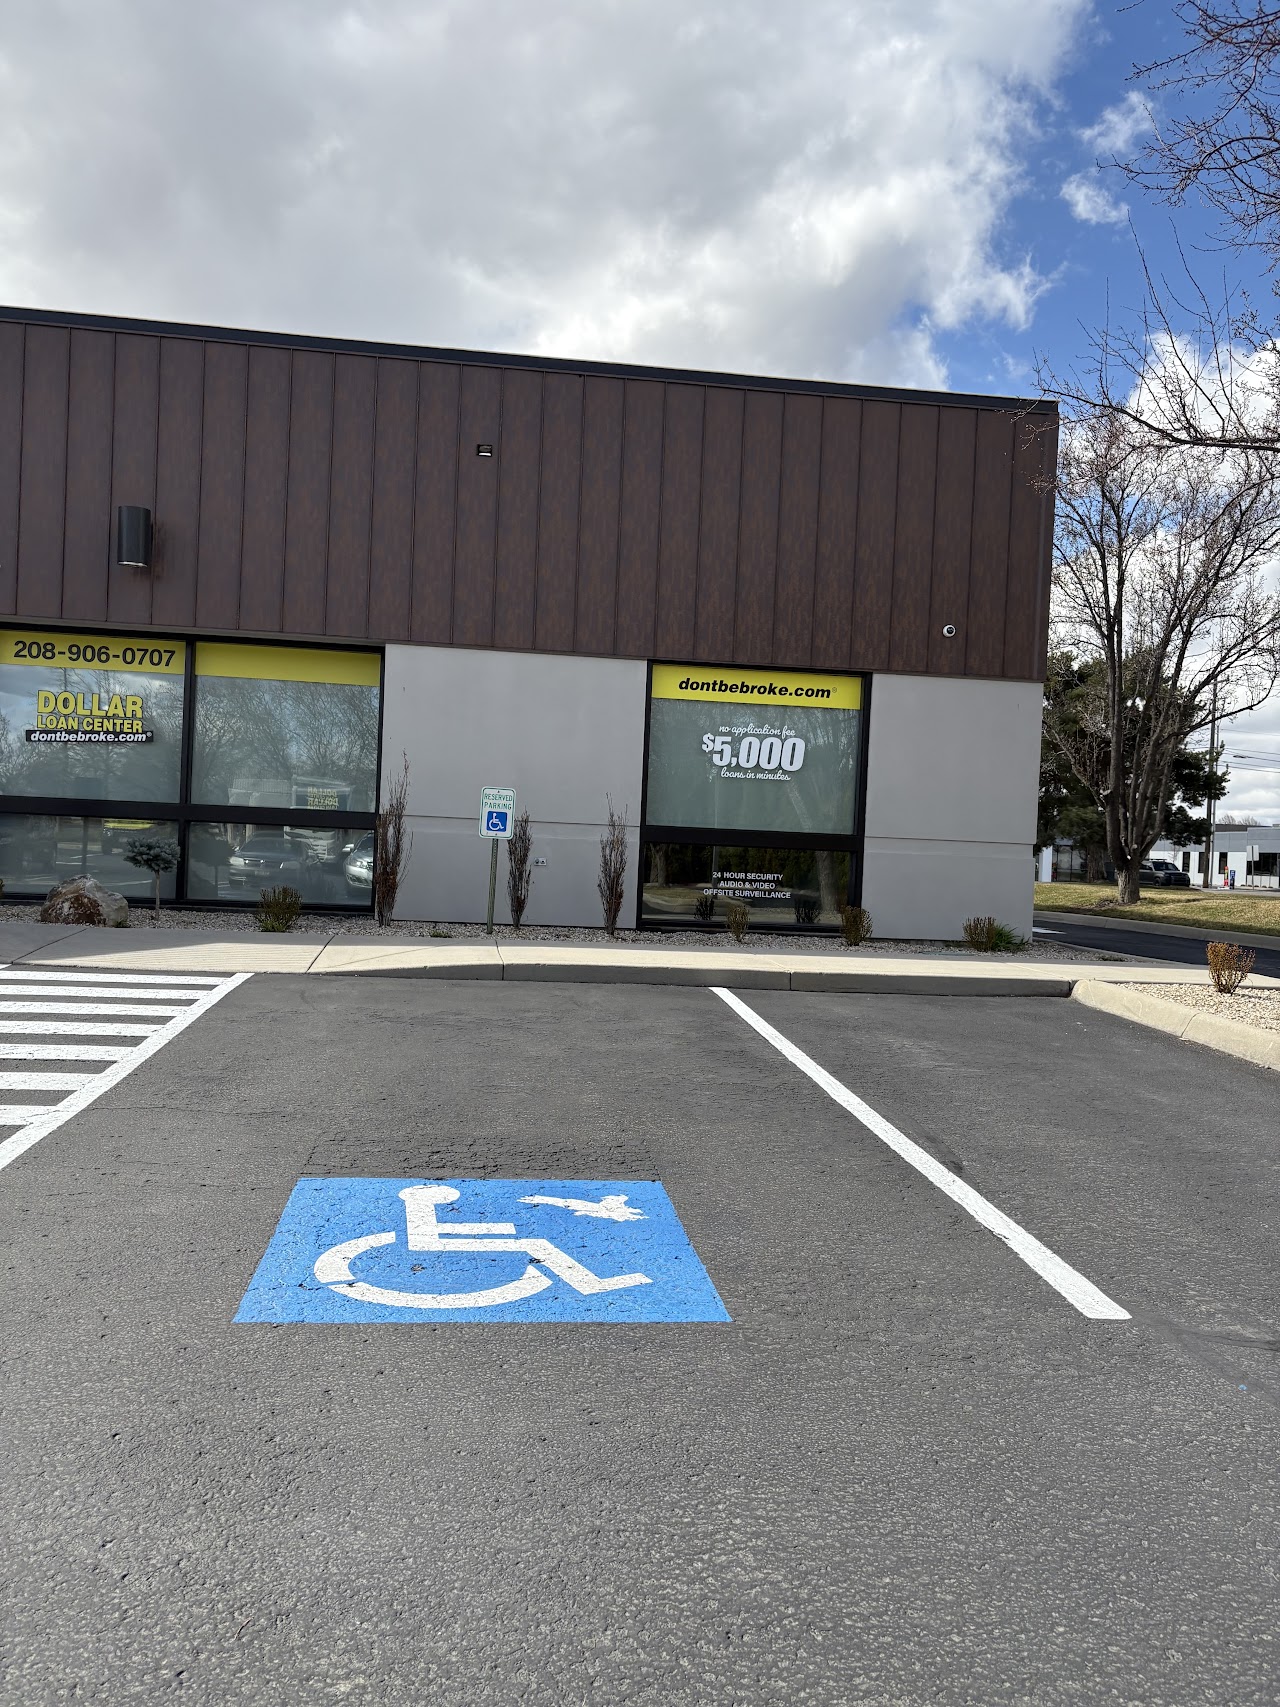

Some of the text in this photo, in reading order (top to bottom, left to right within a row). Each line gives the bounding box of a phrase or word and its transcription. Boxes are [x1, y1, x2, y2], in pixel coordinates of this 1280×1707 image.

[13, 640, 176, 667] 208-906-0707
[37, 690, 143, 718] DOLLAR
[37, 715, 143, 733] LOAN CENTER
[719, 722, 796, 739] no application fee
[701, 732, 806, 772] $5,000
[720, 766, 791, 781] loans in minutes
[484, 802, 512, 810] PARKING
[712, 871, 721, 879] 24
[719, 880, 744, 888] AUDIO
[751, 881, 776, 889] VIDEO
[703, 888, 791, 898] OFFSITE SURVEILLANCE
